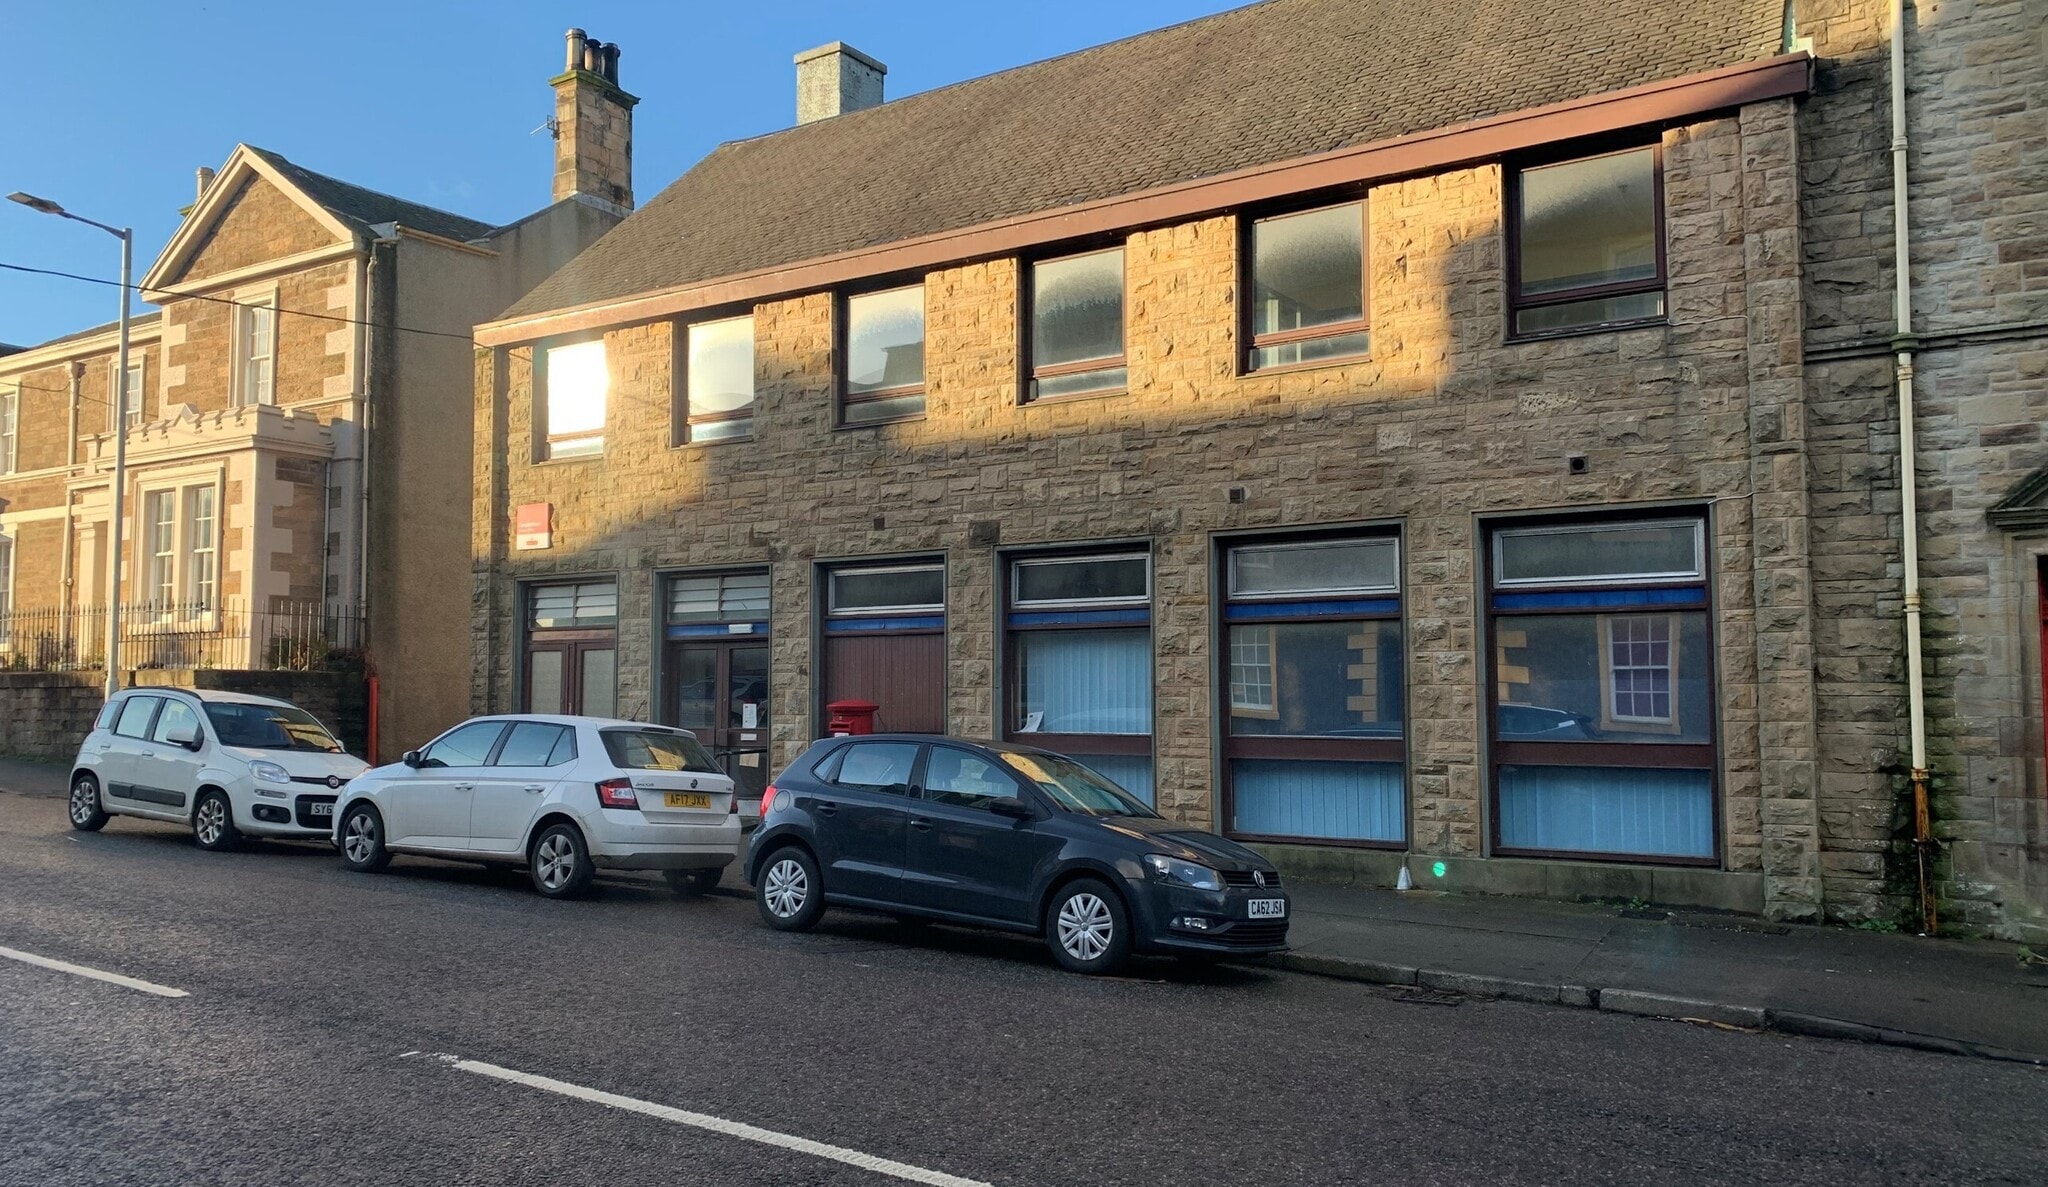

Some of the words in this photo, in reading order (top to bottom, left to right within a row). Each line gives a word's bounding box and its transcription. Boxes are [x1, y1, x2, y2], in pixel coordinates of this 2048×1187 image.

[670, 794, 688, 805] AF17
[691, 795, 706, 806] JXX
[1251, 901, 1270, 915] CA62
